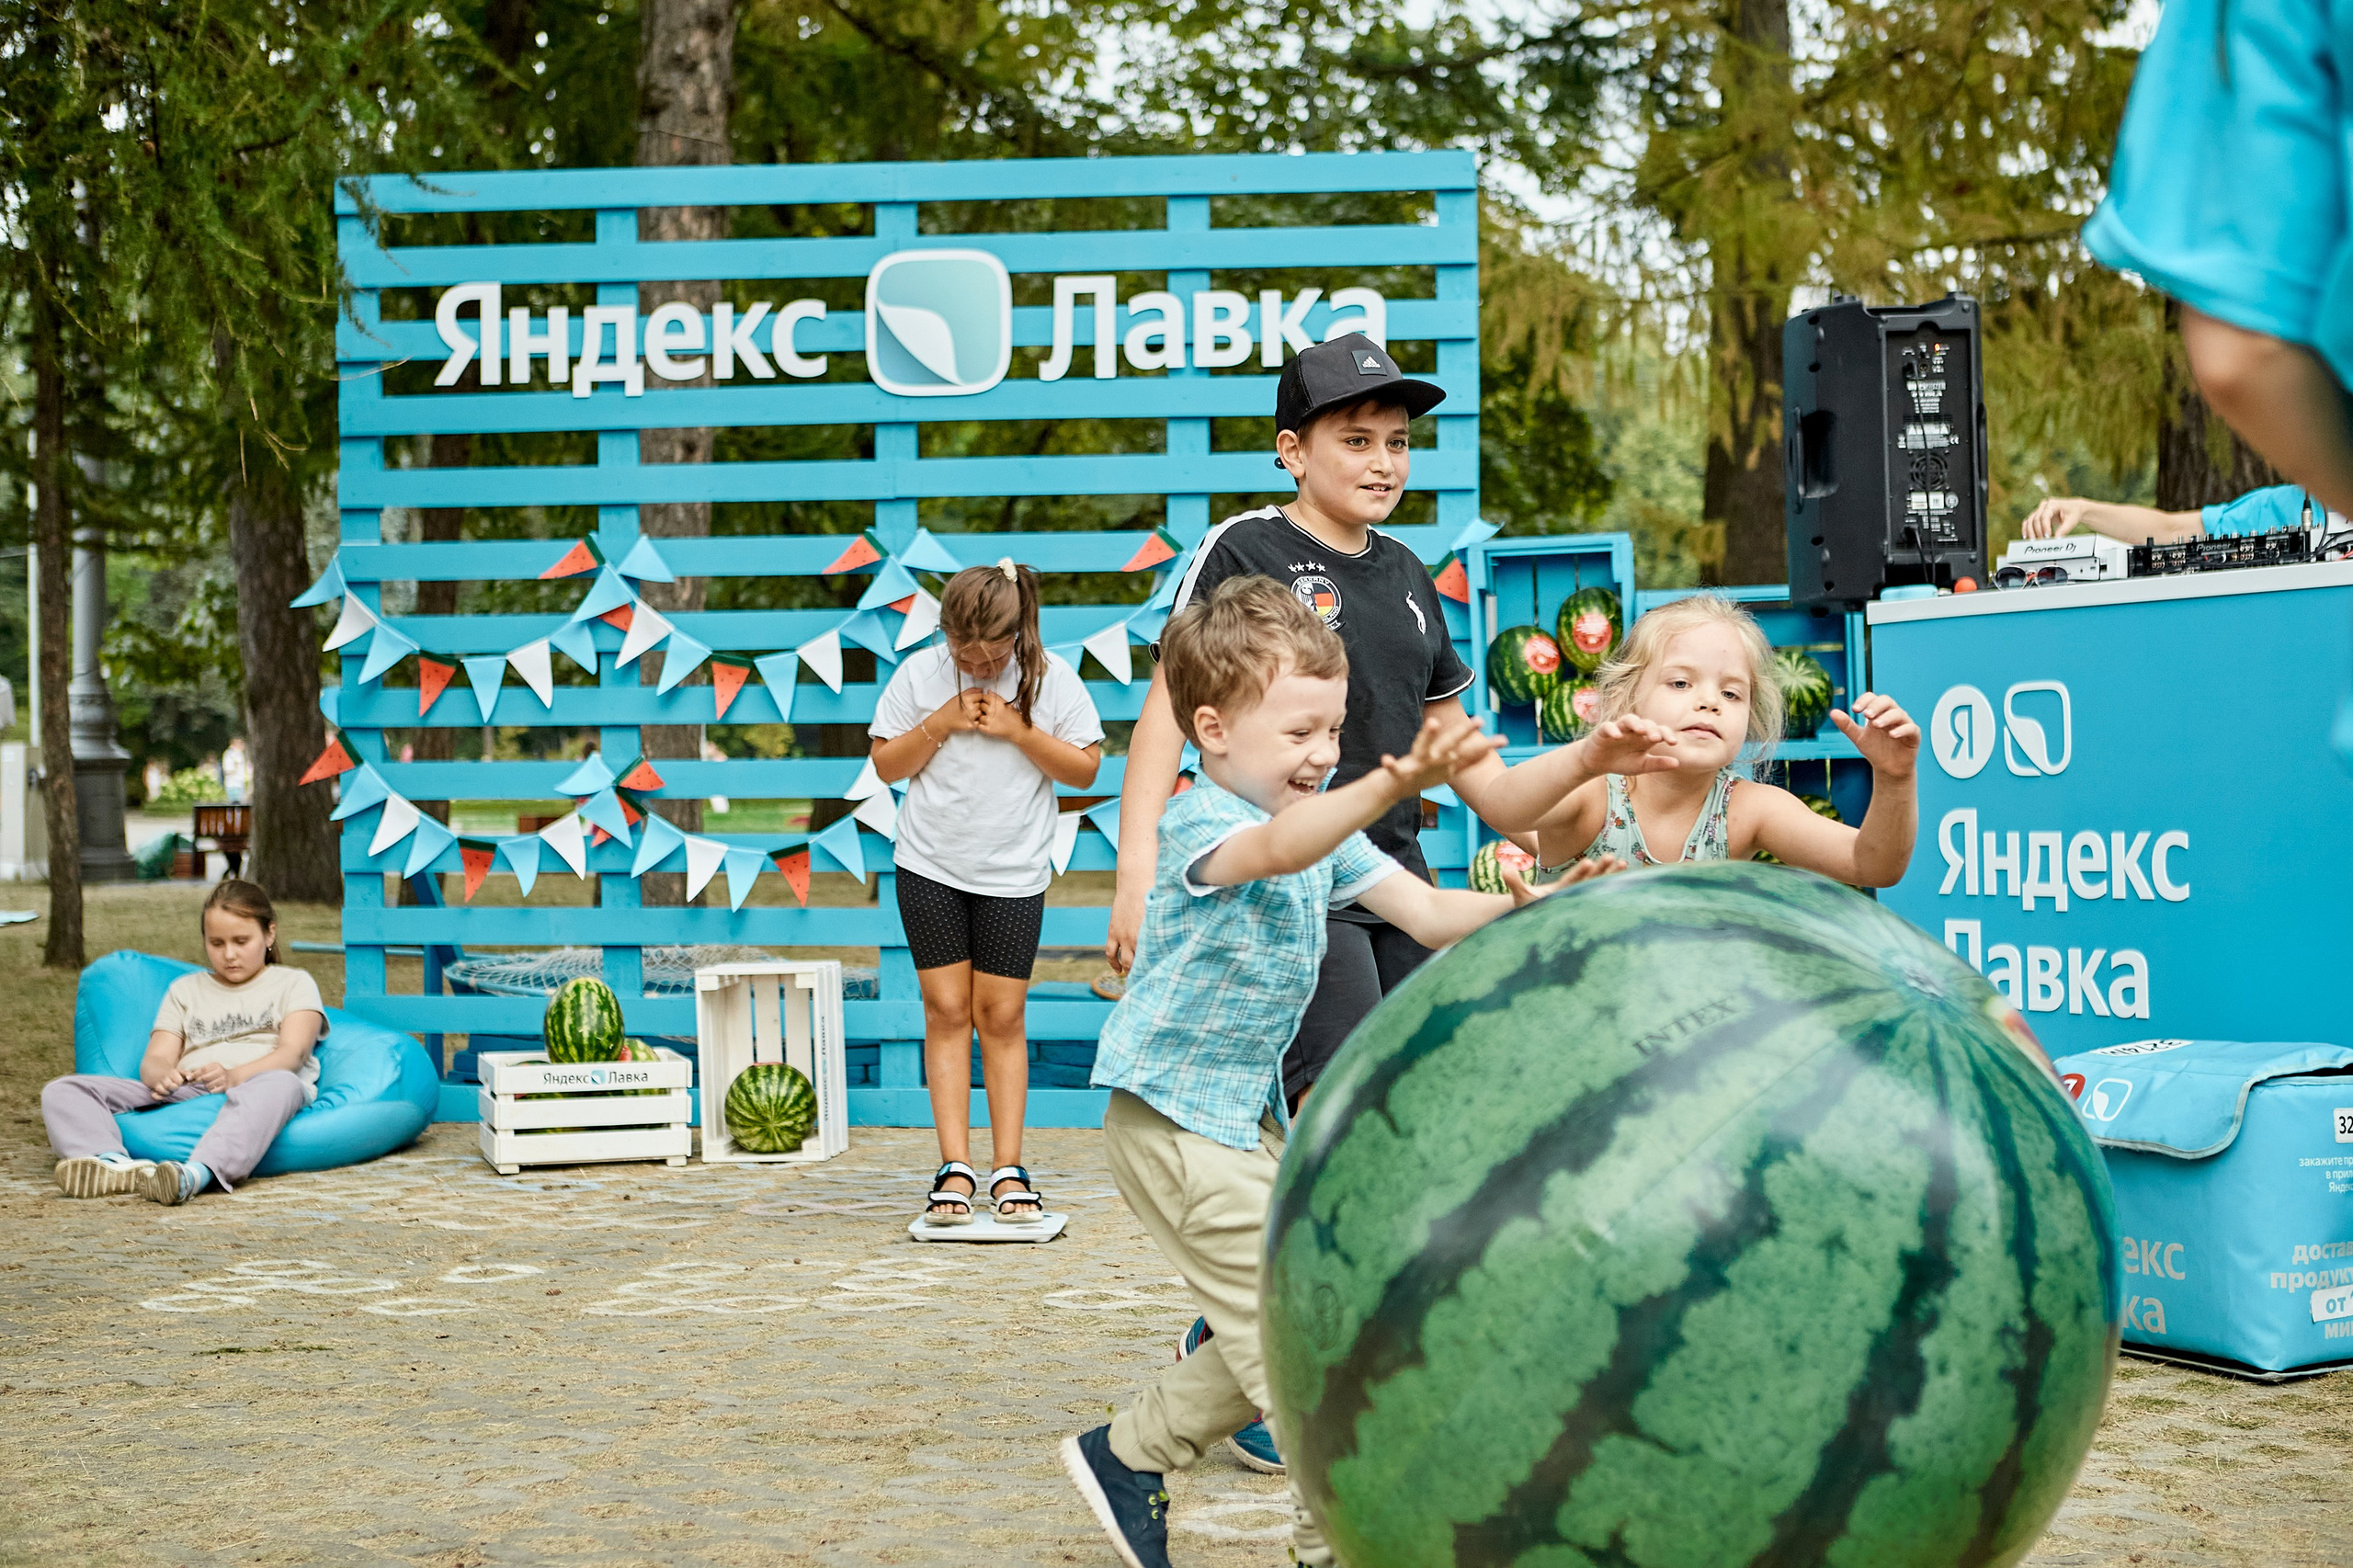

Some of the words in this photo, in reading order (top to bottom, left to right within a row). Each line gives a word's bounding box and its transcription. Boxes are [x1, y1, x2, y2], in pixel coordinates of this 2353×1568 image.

[434, 280, 827, 398] Яндекс
[1949, 704, 1973, 761] Я
[1938, 807, 2189, 912] Яндекс
[1632, 995, 1737, 1056] INTEX
[543, 1073, 589, 1085] Яндекс
[608, 1071, 648, 1084] Лавка
[2299, 1157, 2343, 1166] закажите
[2325, 1170, 2331, 1179] в
[2325, 1297, 2346, 1313] от
